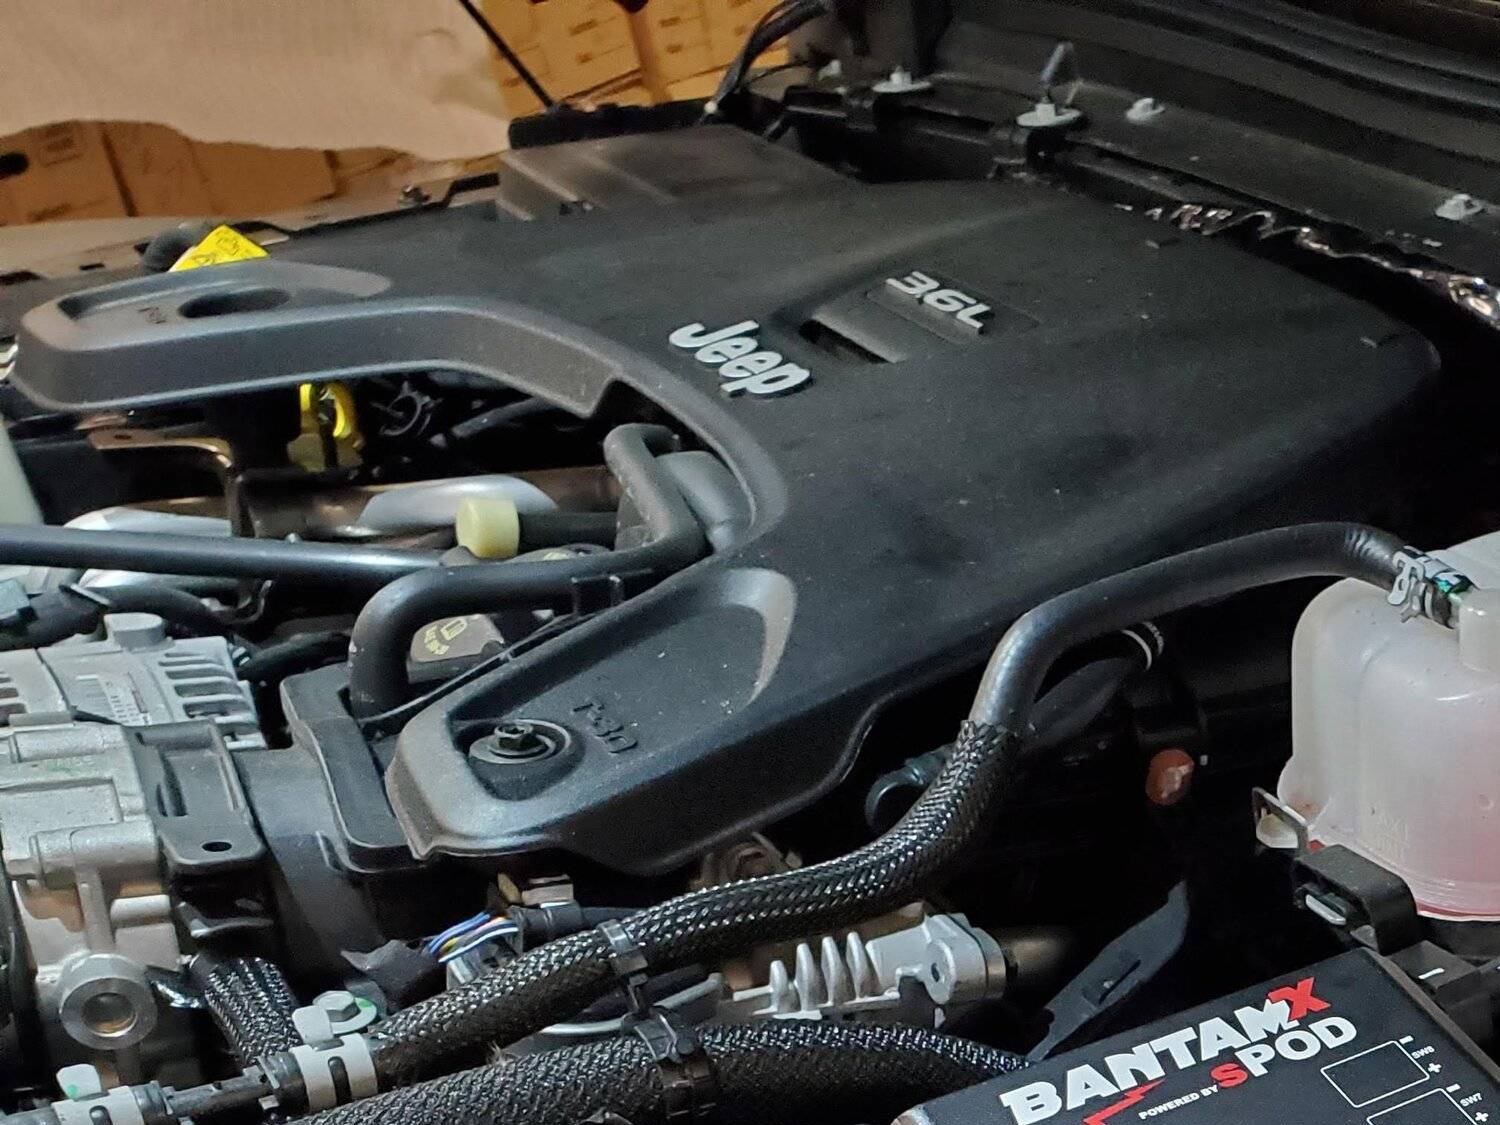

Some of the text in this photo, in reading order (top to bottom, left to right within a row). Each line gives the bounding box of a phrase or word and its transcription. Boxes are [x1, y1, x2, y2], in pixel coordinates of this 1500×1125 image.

[669, 319, 812, 397] Jeep
[1138, 1015, 1358, 1120] POWERED BY SPOD
[1459, 1091, 1484, 1108] SW7
